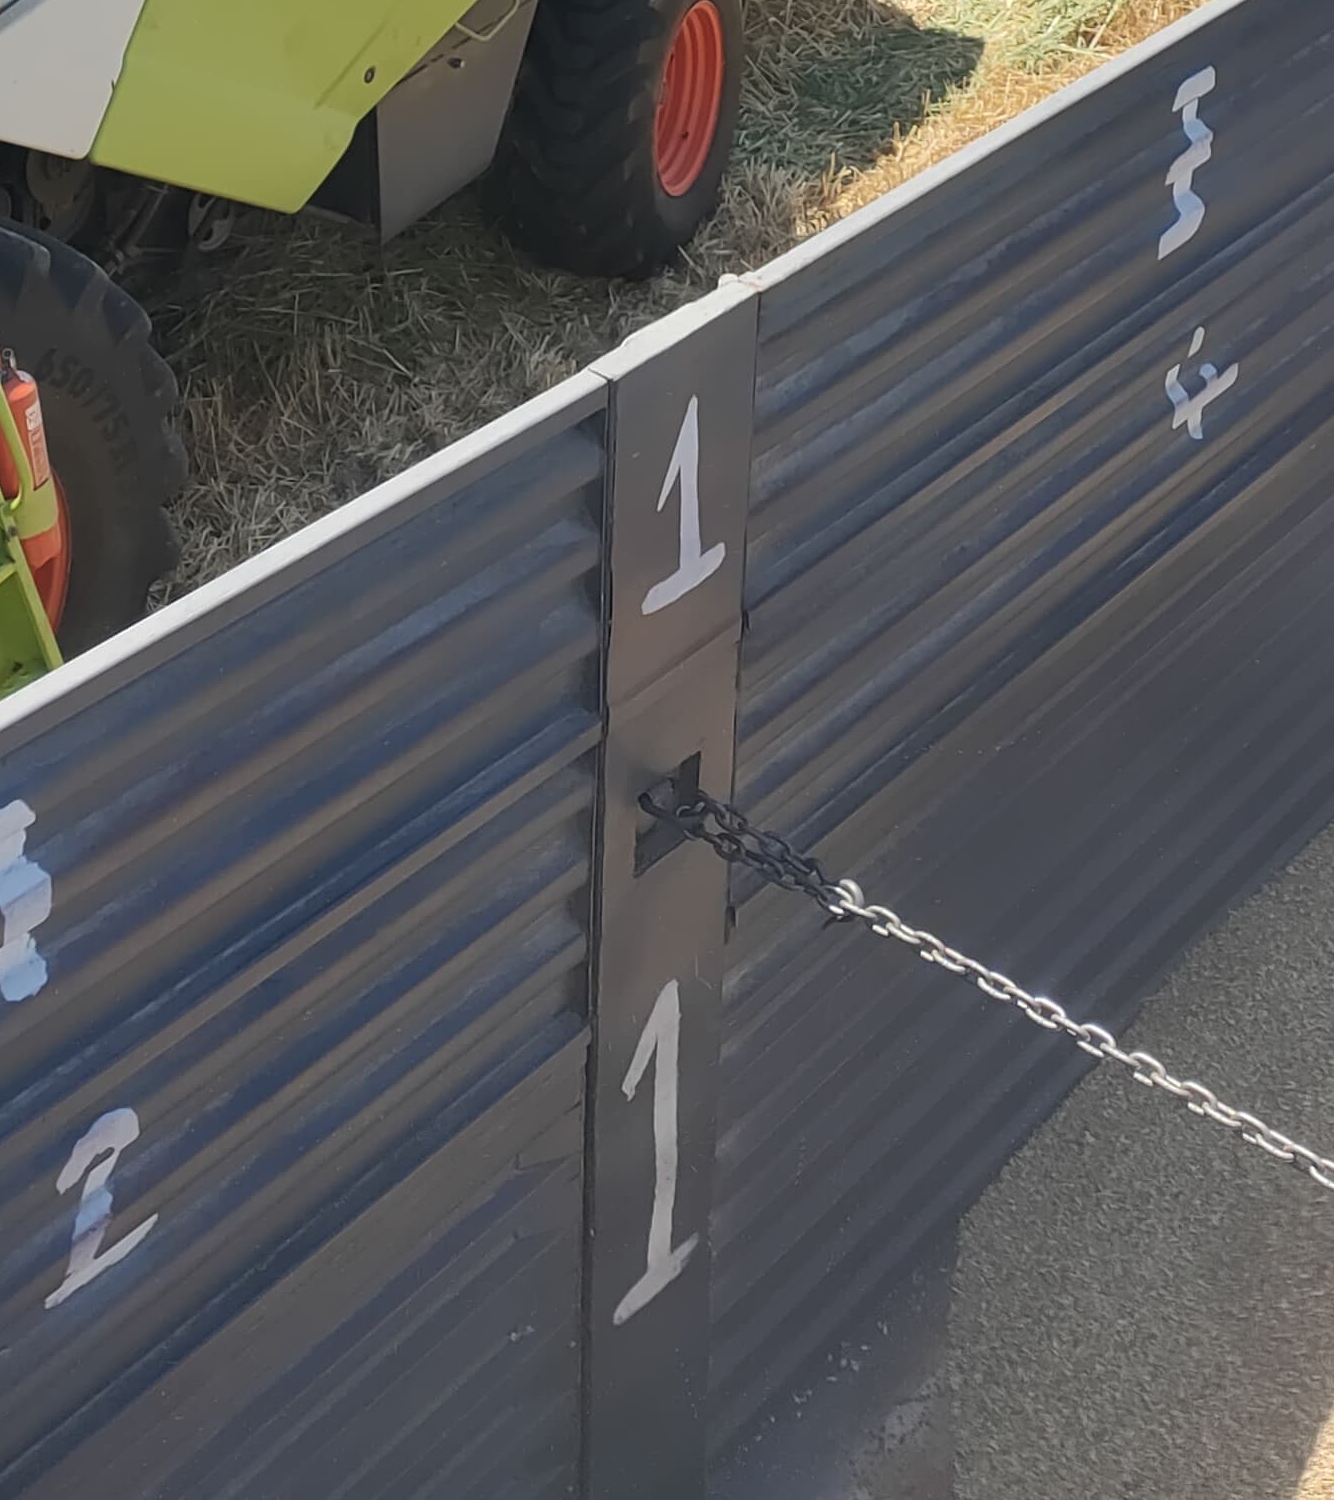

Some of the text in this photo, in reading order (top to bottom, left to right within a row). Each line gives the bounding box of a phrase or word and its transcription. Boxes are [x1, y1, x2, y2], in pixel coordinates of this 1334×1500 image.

[641, 394, 727, 615] 1
[45, 1106, 159, 1309] 2
[613, 979, 699, 1326] 1
